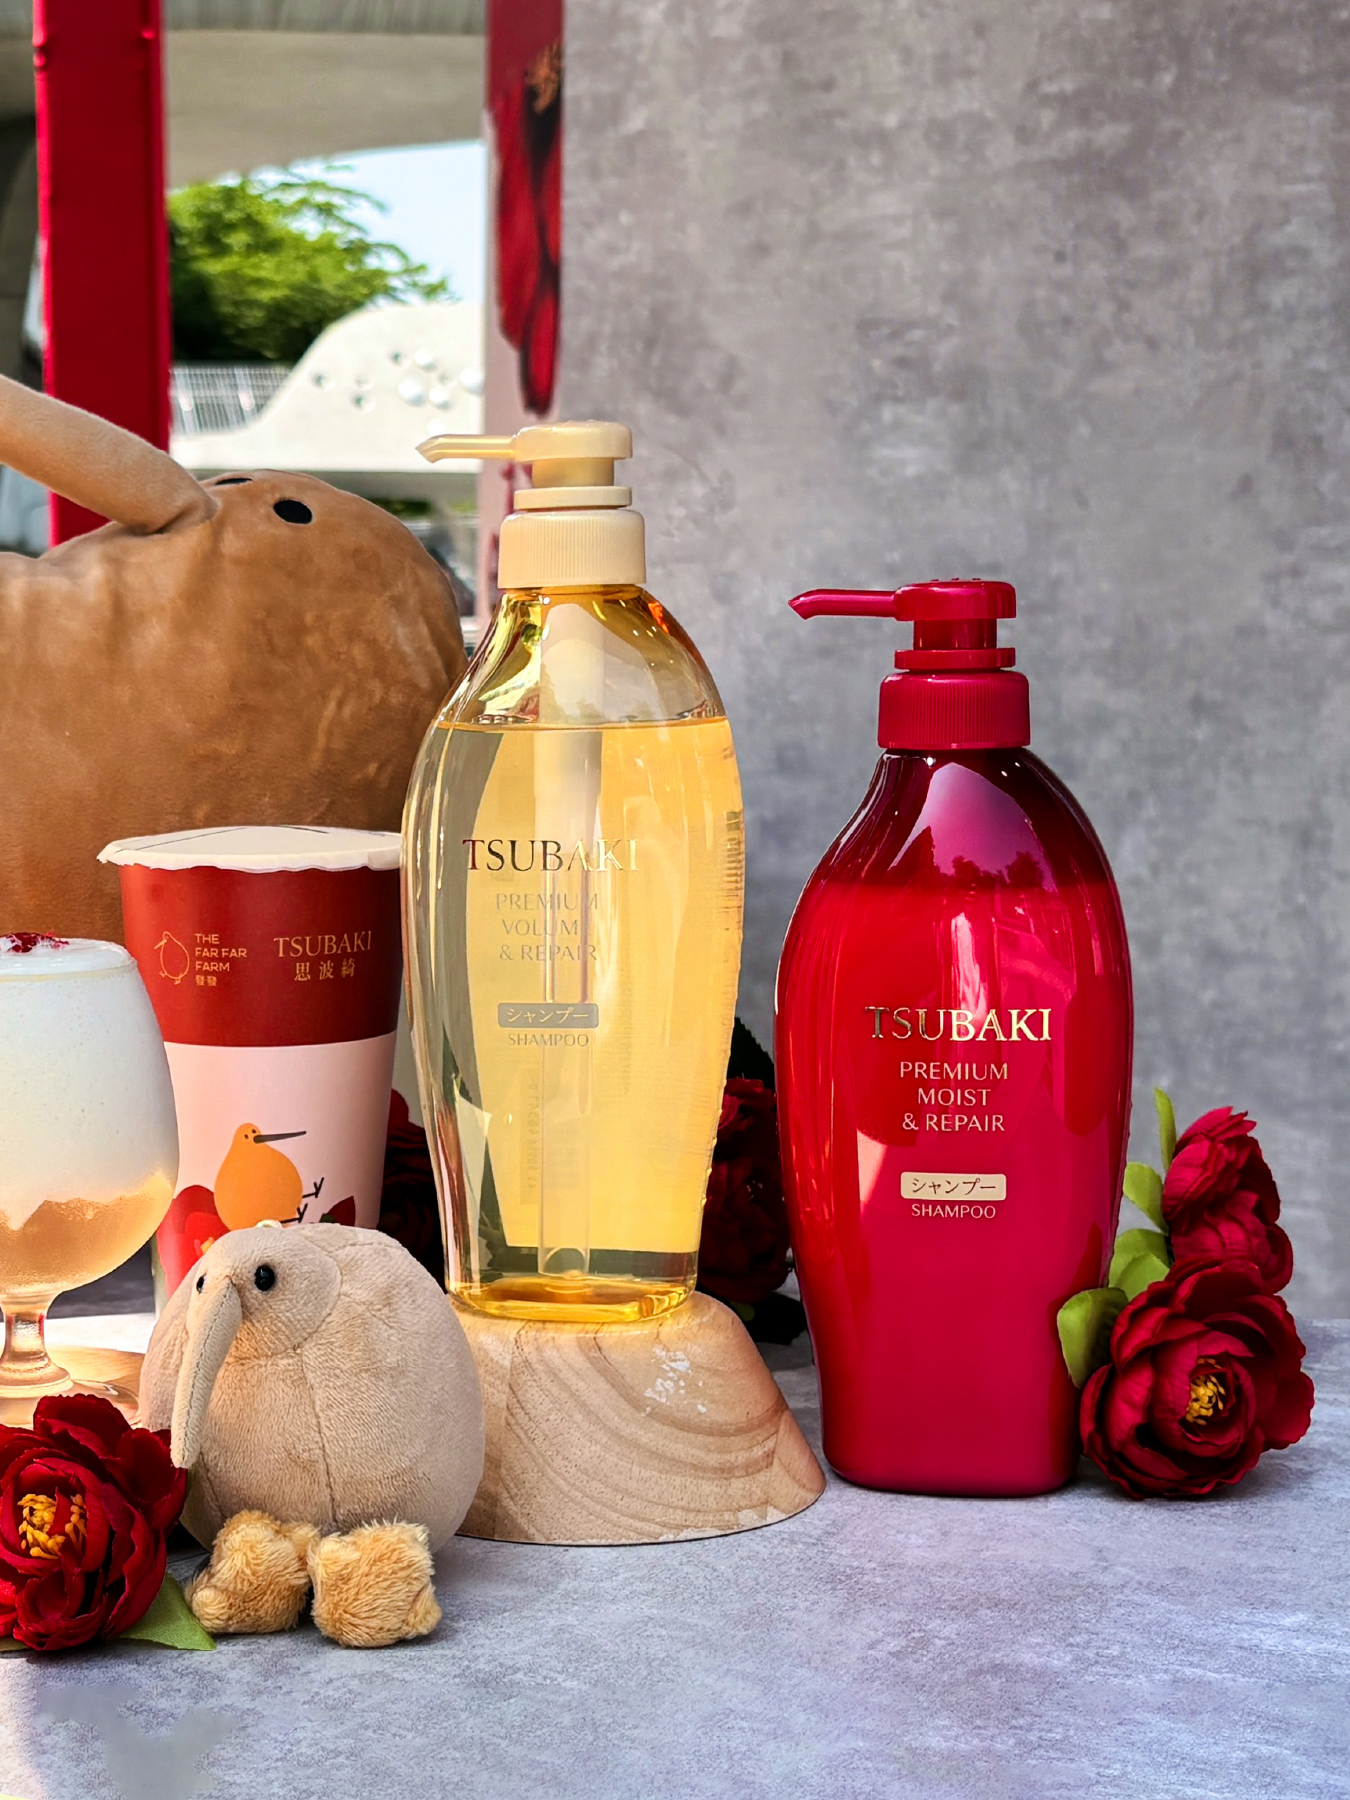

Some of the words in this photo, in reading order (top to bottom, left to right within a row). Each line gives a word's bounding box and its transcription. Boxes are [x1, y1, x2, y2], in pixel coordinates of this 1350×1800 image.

[462, 838, 639, 872] TSUBAKI
[496, 893, 598, 910] PREMIUM
[501, 918, 594, 936] VOLUM
[195, 933, 220, 944] THE
[273, 930, 372, 958] TSUBAKI
[195, 947, 219, 958] FAR
[221, 948, 247, 958] FAR
[499, 944, 514, 961] &
[521, 944, 597, 961] REPAIR
[195, 961, 230, 972] FARM
[294, 958, 355, 981] 思波綺
[506, 1006, 590, 1024] シャンプー
[865, 1006, 1052, 1042] TSUBAKI
[508, 1033, 589, 1047] SHAMPOO
[900, 1061, 1009, 1081] PREMIUM
[917, 1088, 991, 1107] MOIST
[902, 1114, 919, 1131] &
[926, 1114, 1006, 1132] REPAIR
[910, 1177, 997, 1197] シャンプー
[911, 1203, 997, 1220] SHAMPOO
